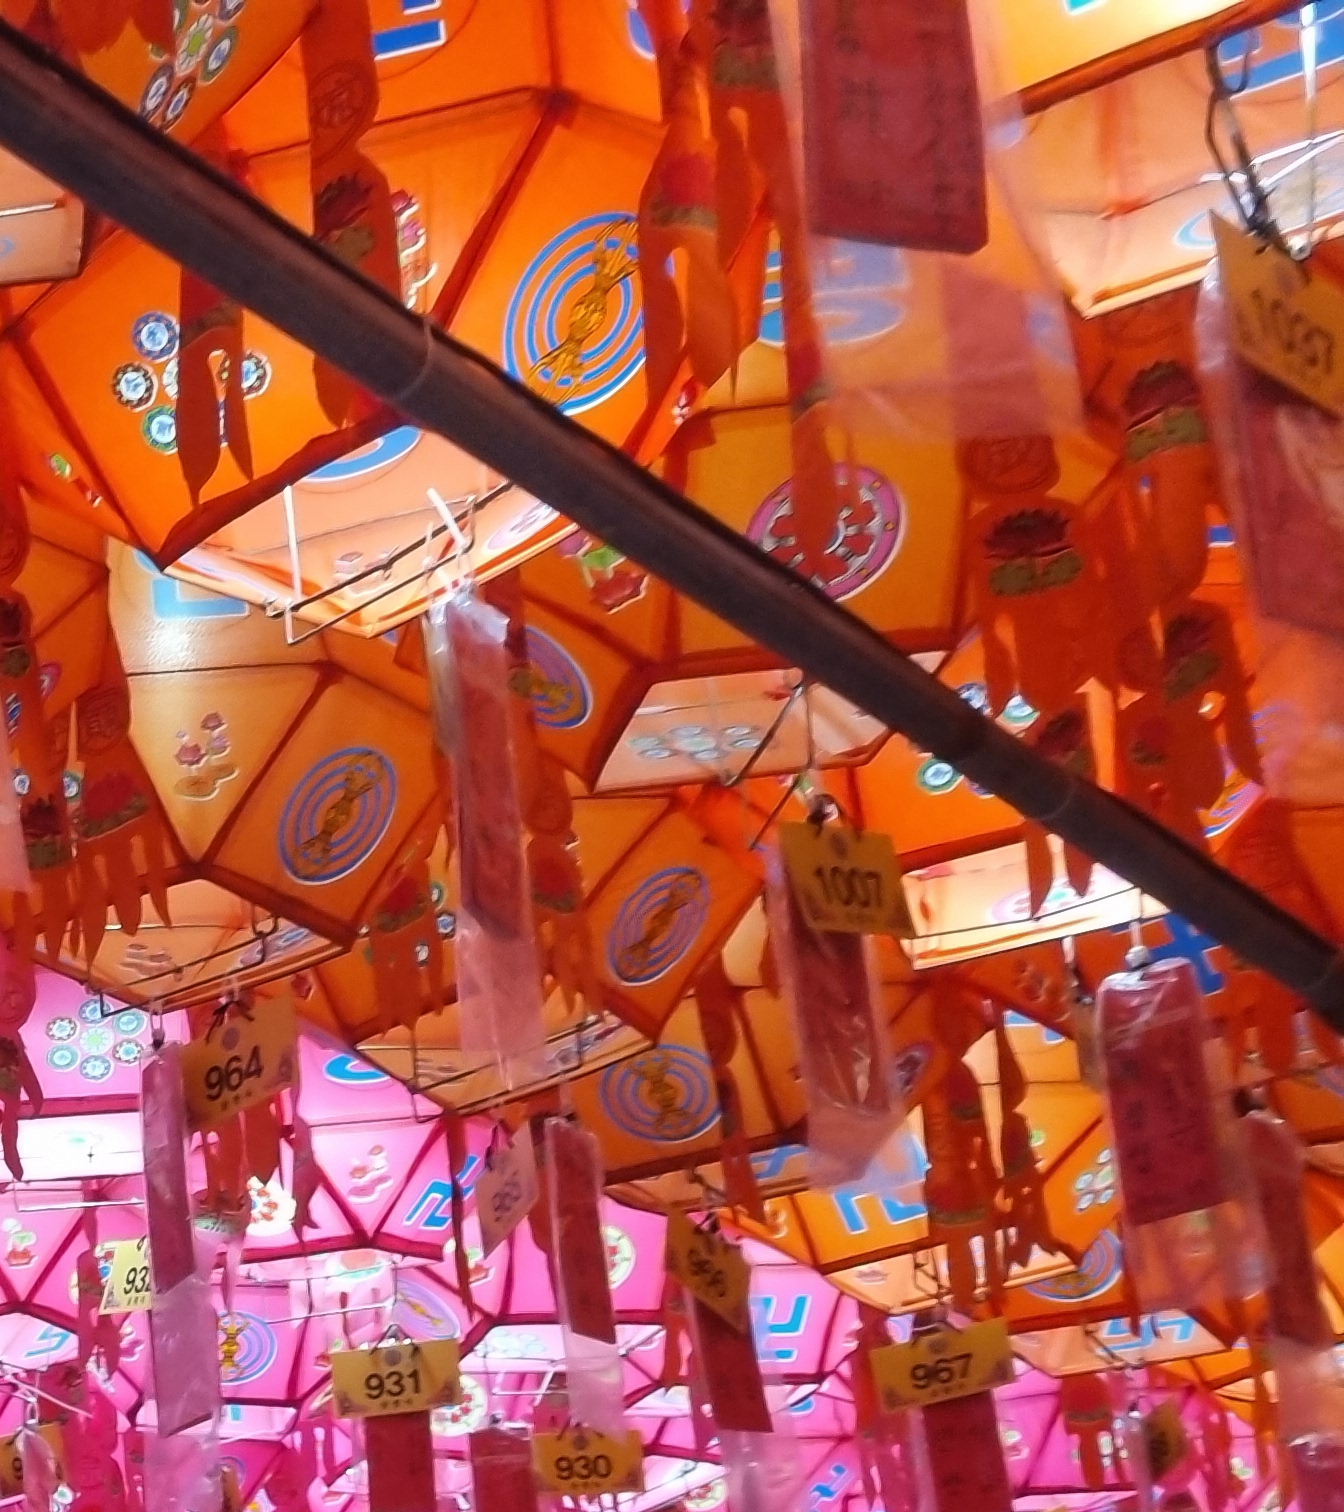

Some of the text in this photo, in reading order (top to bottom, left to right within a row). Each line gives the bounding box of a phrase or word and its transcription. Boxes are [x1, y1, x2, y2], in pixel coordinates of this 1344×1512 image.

[205, 1045, 264, 1102] 964
[365, 1369, 423, 1400] 931
[910, 1353, 973, 1389] 967
[555, 1455, 611, 1481] 930
